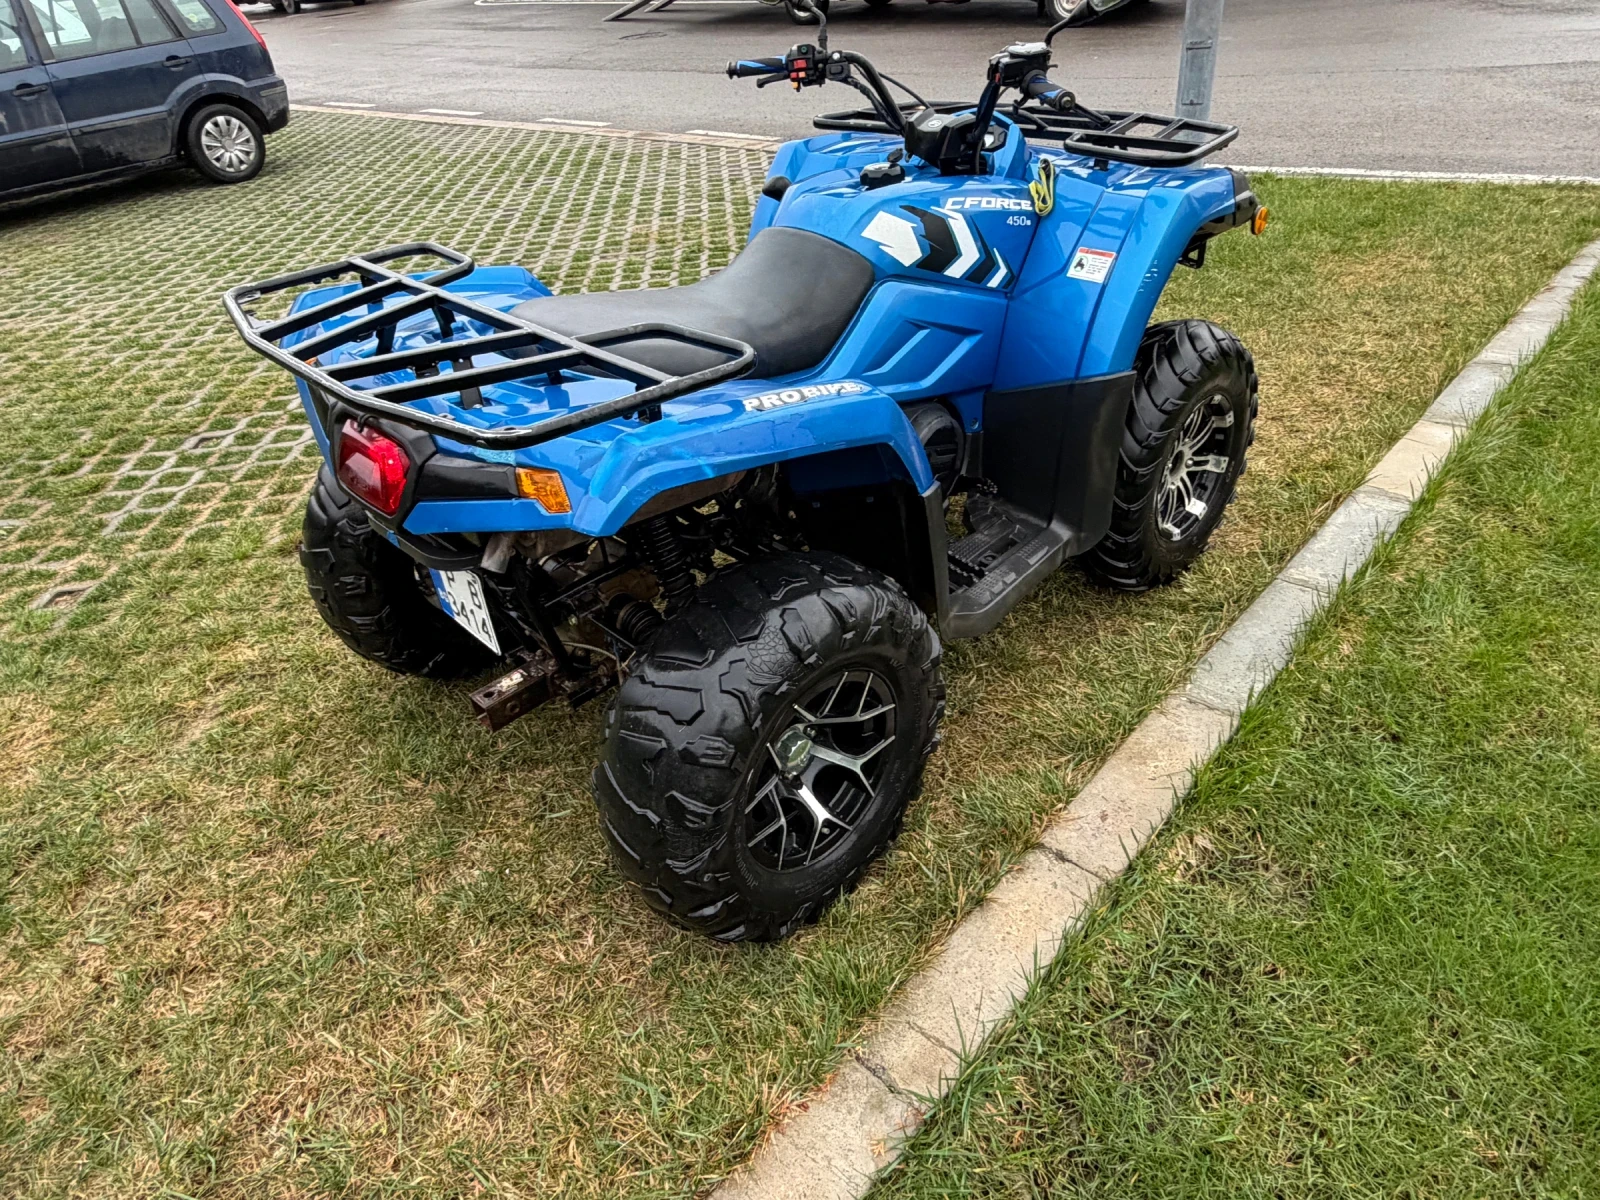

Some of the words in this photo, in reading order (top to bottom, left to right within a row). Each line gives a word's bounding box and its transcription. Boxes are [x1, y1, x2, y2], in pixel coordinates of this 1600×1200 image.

[944, 196, 1033, 211] CFORCE
[742, 389, 801, 412] PRO
[801, 382, 861, 398] BIKE
[447, 590, 493, 643] 3414
